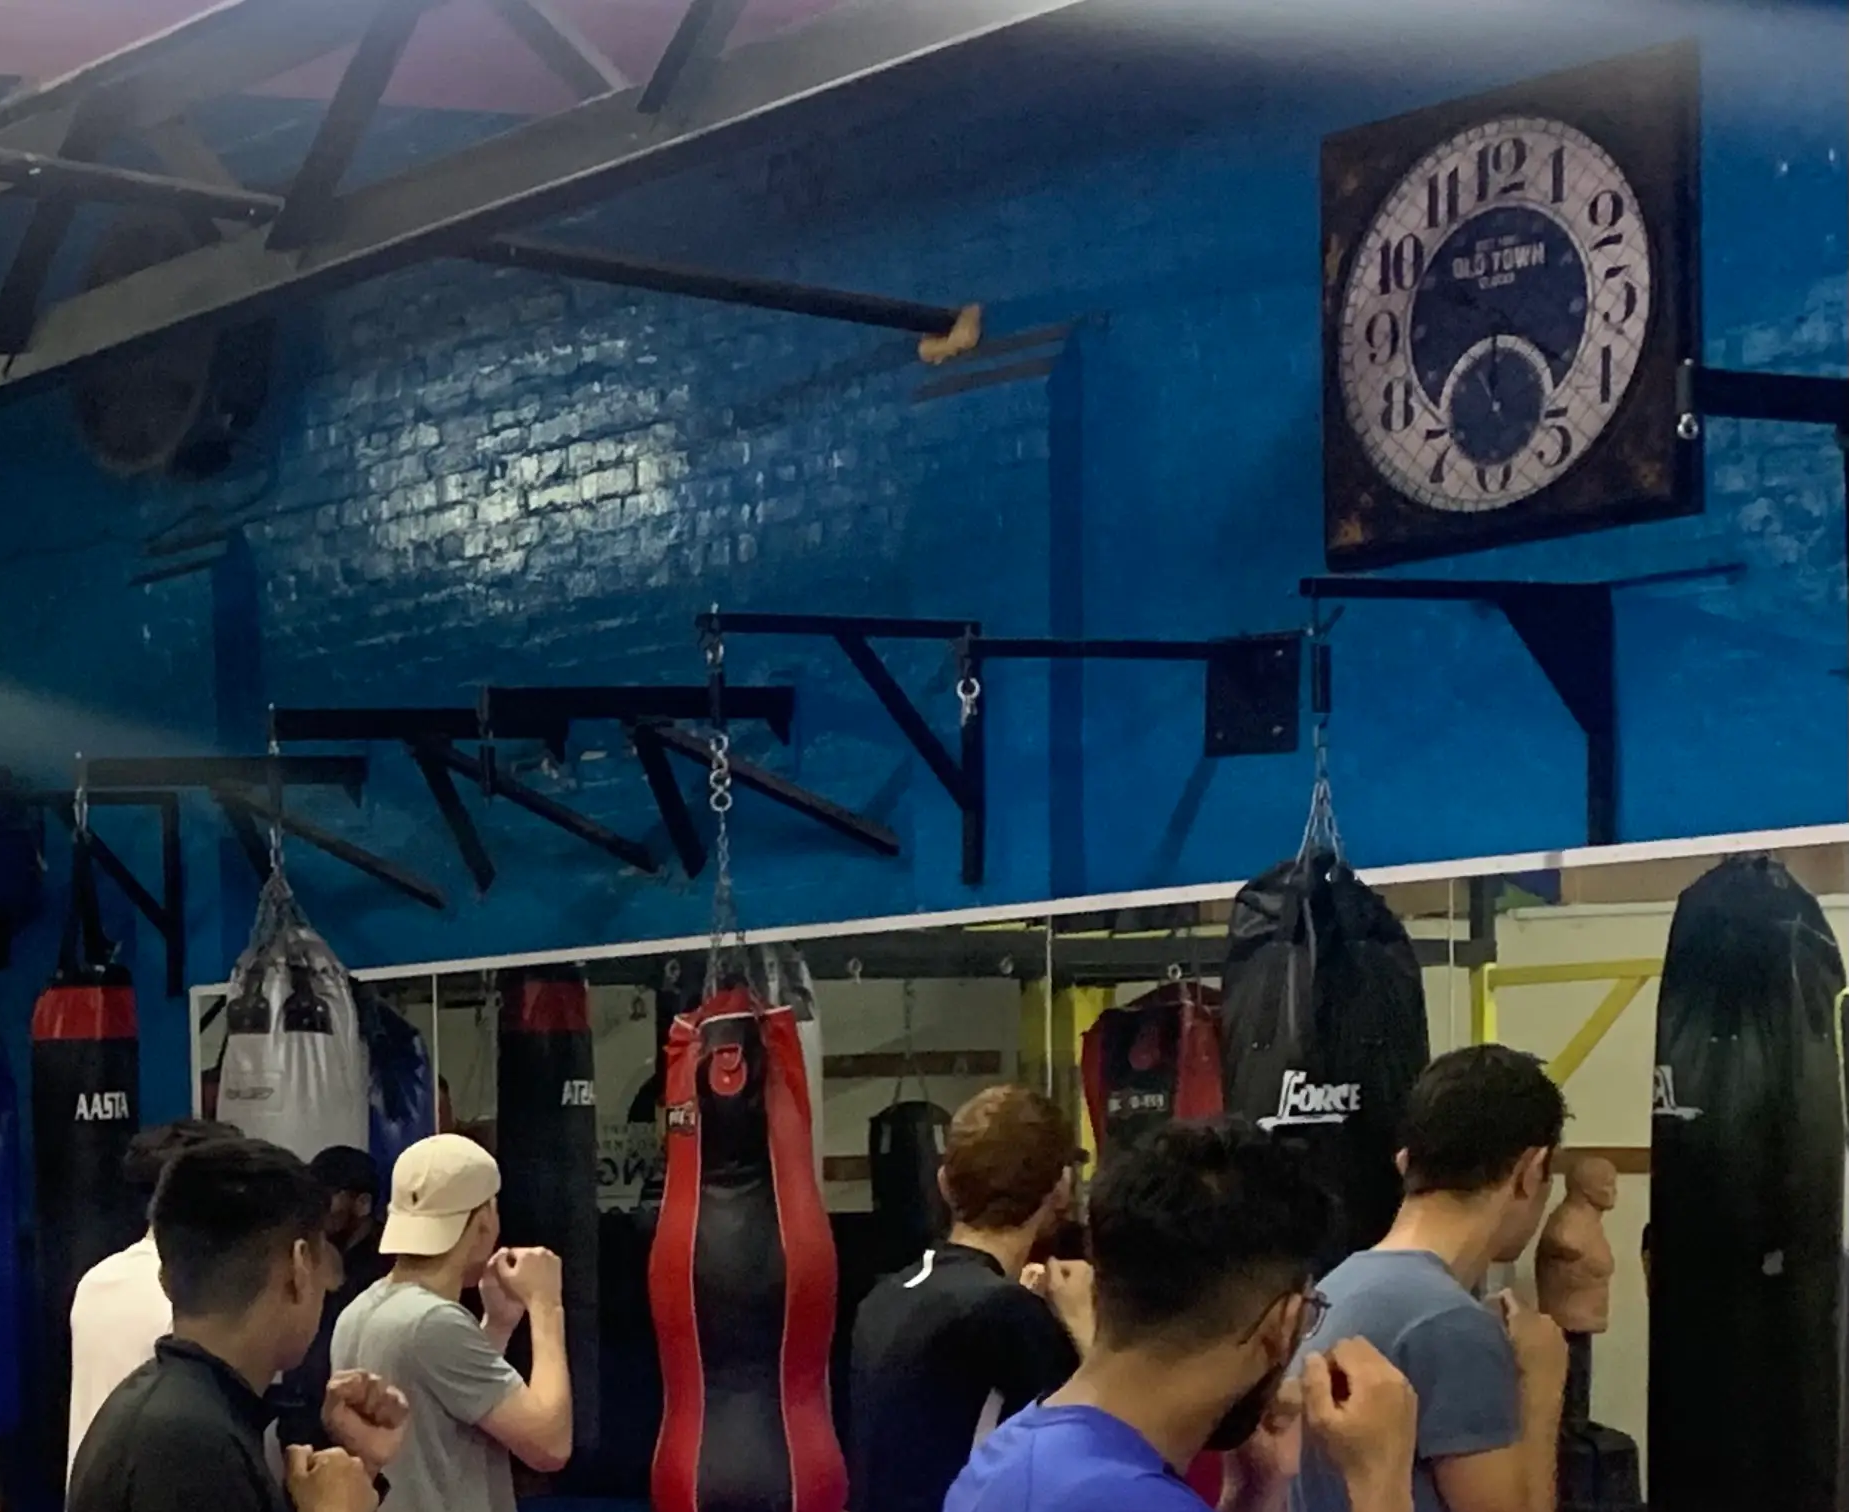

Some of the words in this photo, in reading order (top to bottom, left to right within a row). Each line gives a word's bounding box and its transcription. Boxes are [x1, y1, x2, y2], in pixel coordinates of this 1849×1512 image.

[1426, 166, 1460, 229] 11
[1476, 137, 1527, 202] 12
[1549, 146, 1566, 204] 1
[1588, 189, 1624, 251] 2
[1378, 233, 1424, 296] 10
[1452, 252, 1486, 280] OLD
[1491, 241, 1546, 270] TOWN
[1603, 264, 1638, 326] 3
[1365, 309, 1400, 366] 9
[1381, 377, 1414, 432] 8
[1424, 427, 1453, 484] 7
[1536, 406, 1573, 468] 5
[74, 1091, 129, 1121] AASTA
